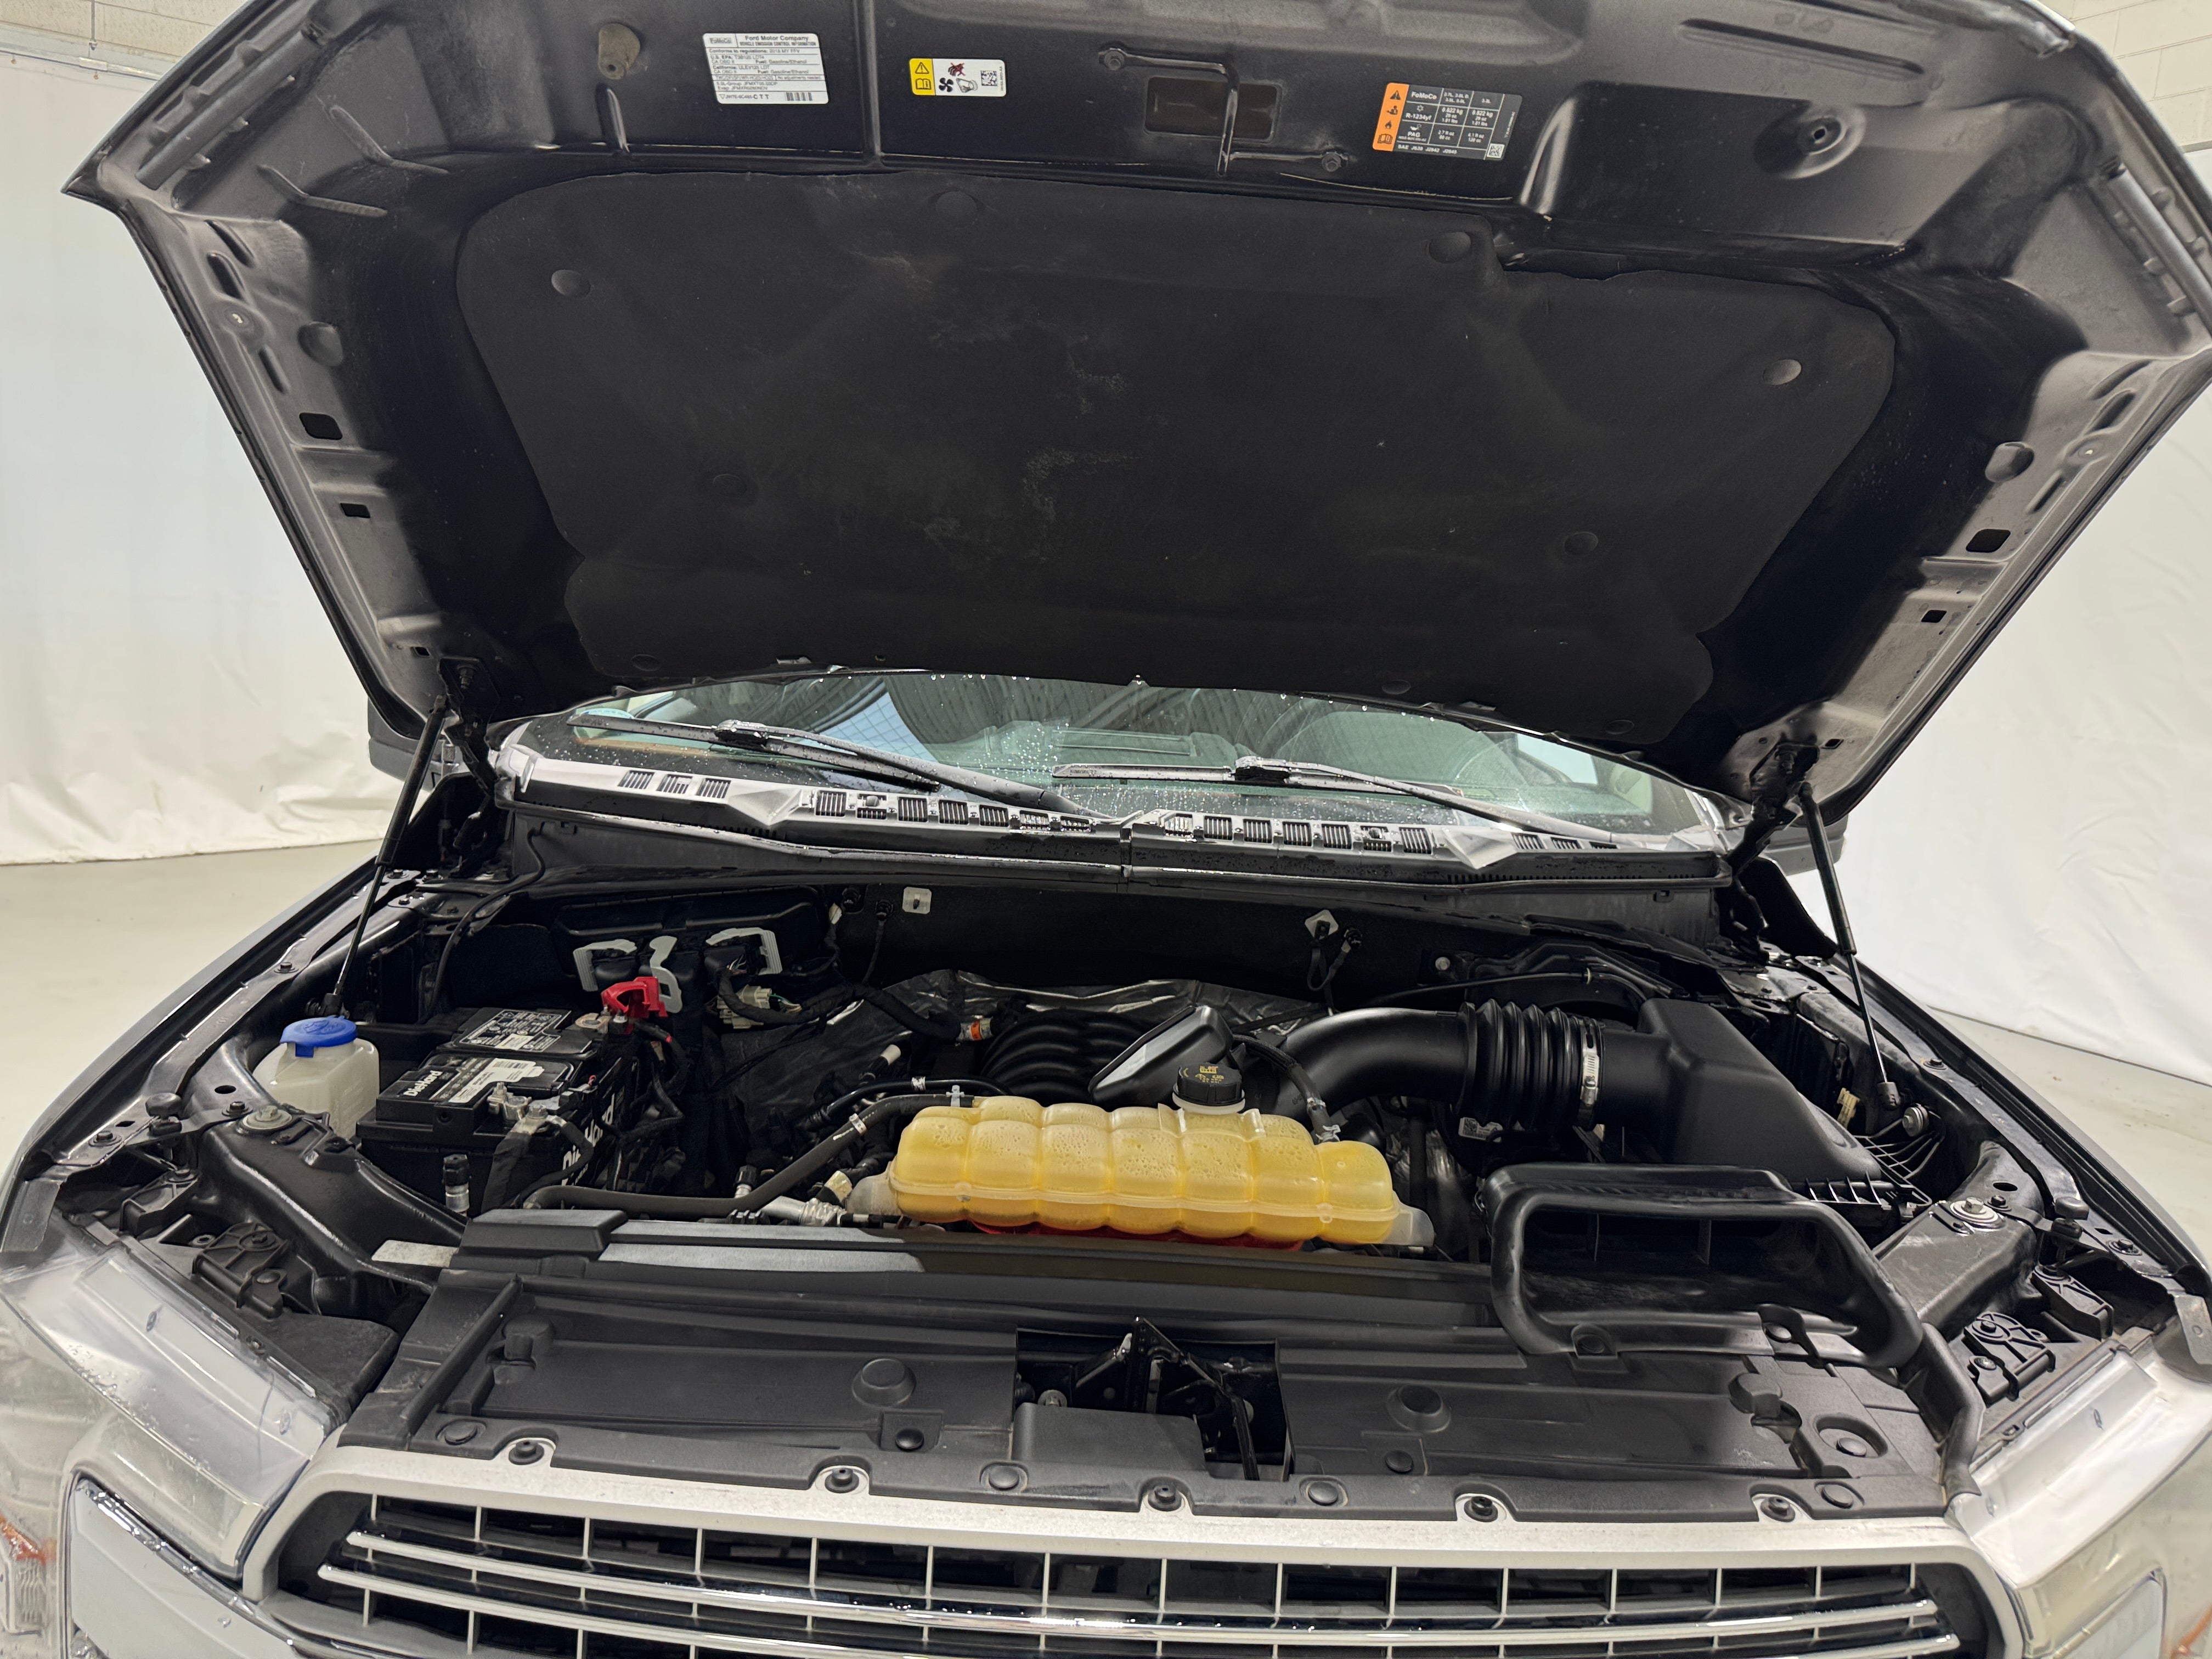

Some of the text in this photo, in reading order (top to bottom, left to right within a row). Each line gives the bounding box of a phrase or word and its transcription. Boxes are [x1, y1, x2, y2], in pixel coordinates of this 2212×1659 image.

[1411, 91, 1437, 100] FoMoCo
[1406, 112, 1432, 121] R-1234yf
[403, 1070, 443, 1097] DieHard
